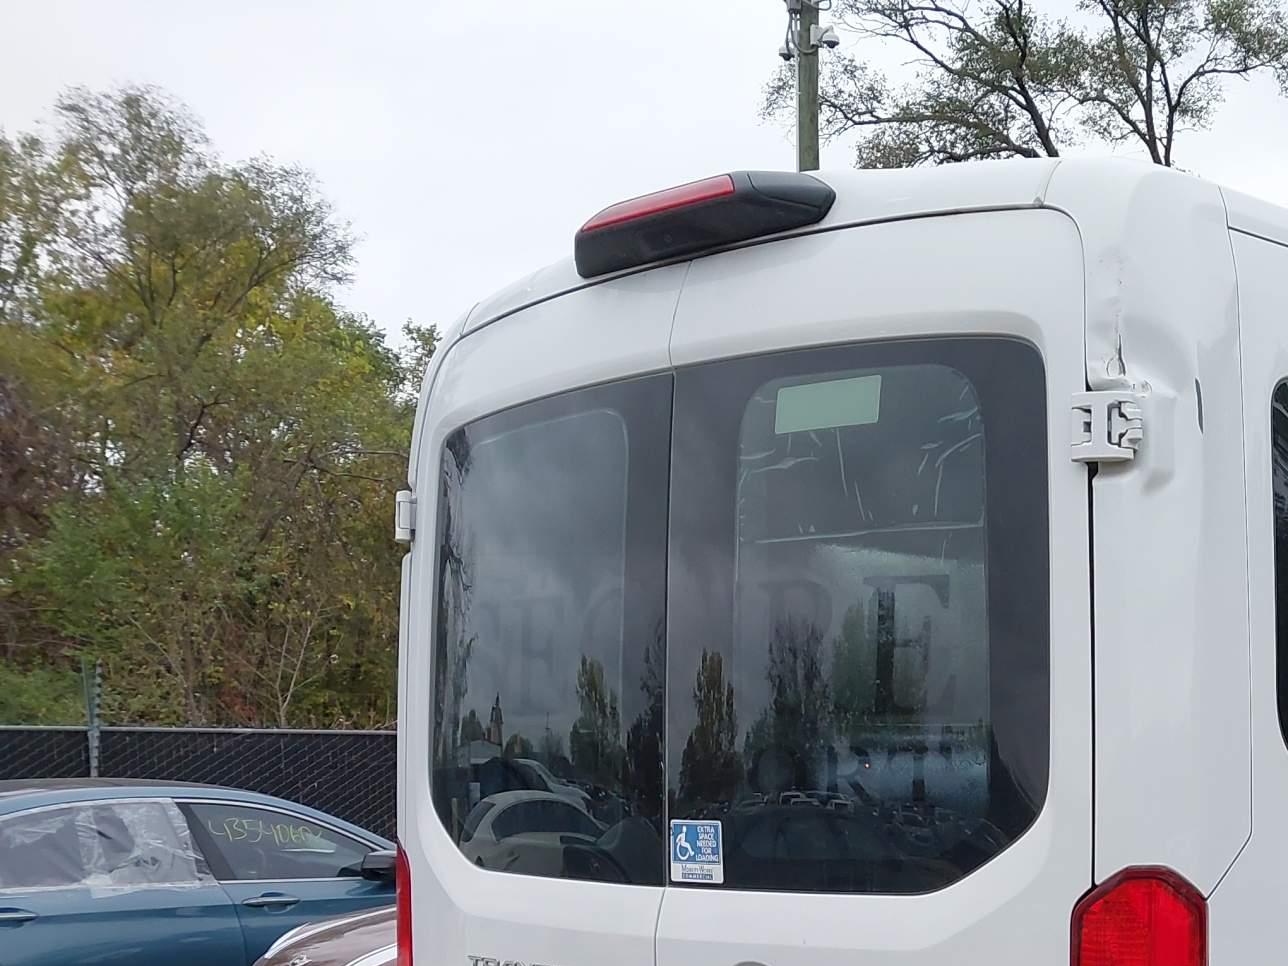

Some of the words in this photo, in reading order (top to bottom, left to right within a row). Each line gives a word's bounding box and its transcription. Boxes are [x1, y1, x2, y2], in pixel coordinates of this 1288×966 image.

[696, 825, 715, 833] EXTRA
[698, 833, 714, 841] SPACE
[696, 840, 717, 848] NEEDED
[701, 847, 712, 855] FOR
